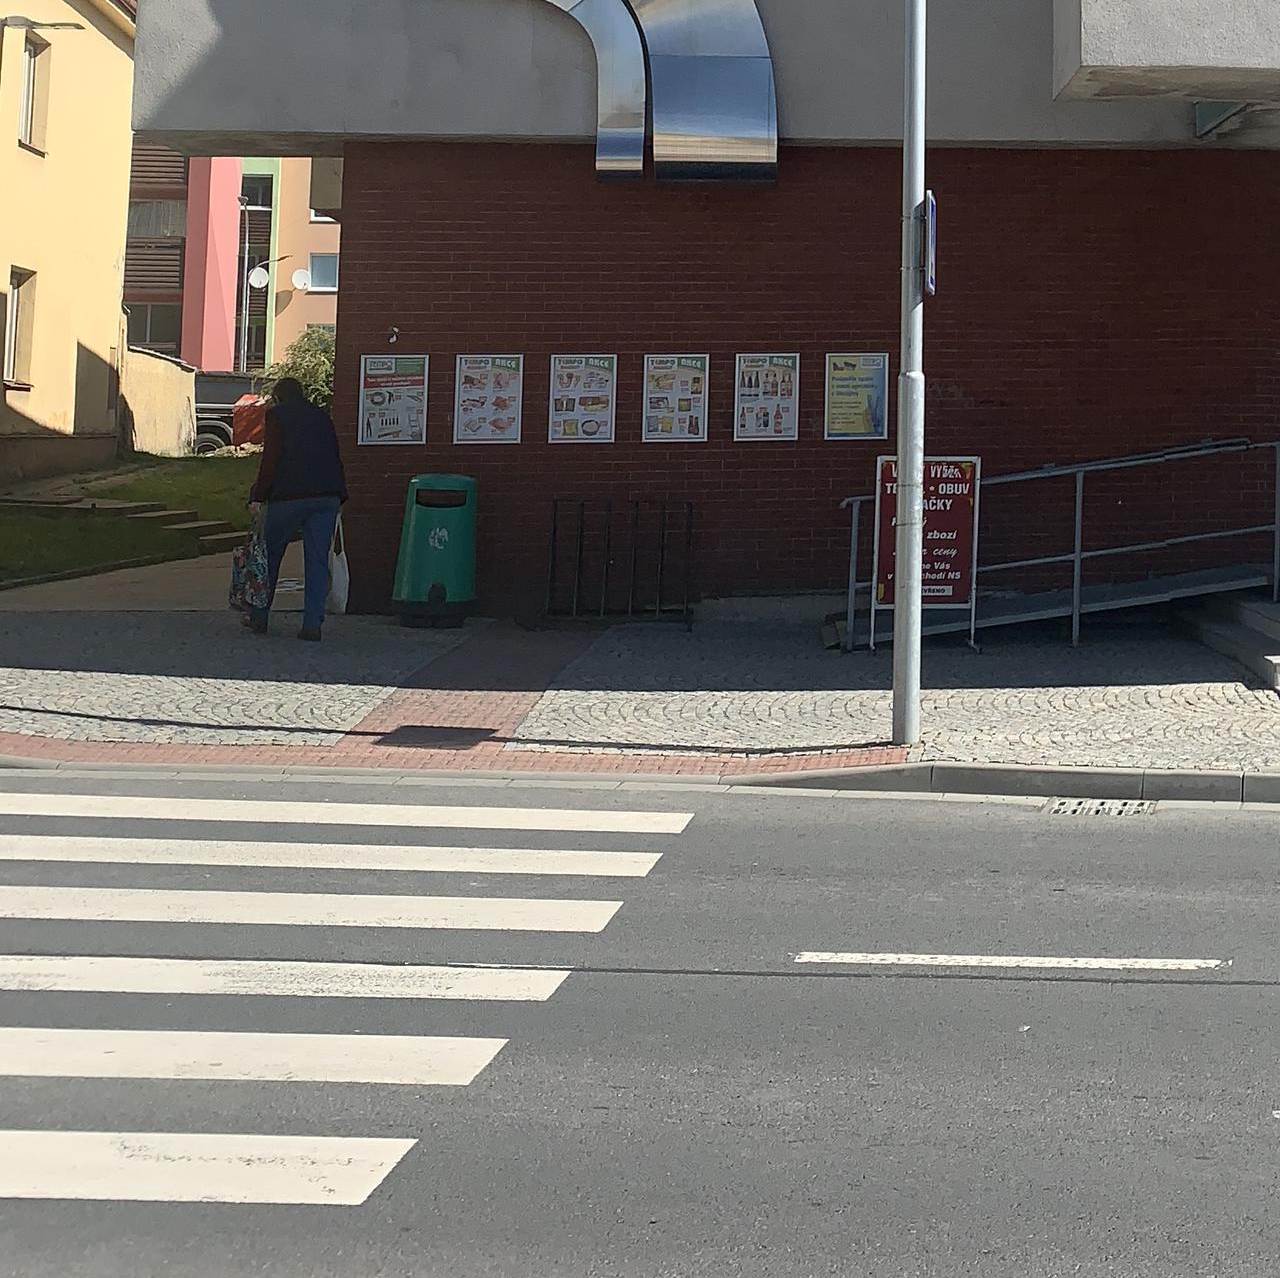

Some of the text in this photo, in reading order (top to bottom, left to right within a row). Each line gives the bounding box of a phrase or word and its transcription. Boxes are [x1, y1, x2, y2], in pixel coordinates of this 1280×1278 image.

[938, 482, 970, 495] OBUV
[923, 496, 953, 511] AČKY
[932, 547, 959, 558] ceny
[934, 561, 951, 570] Vás
